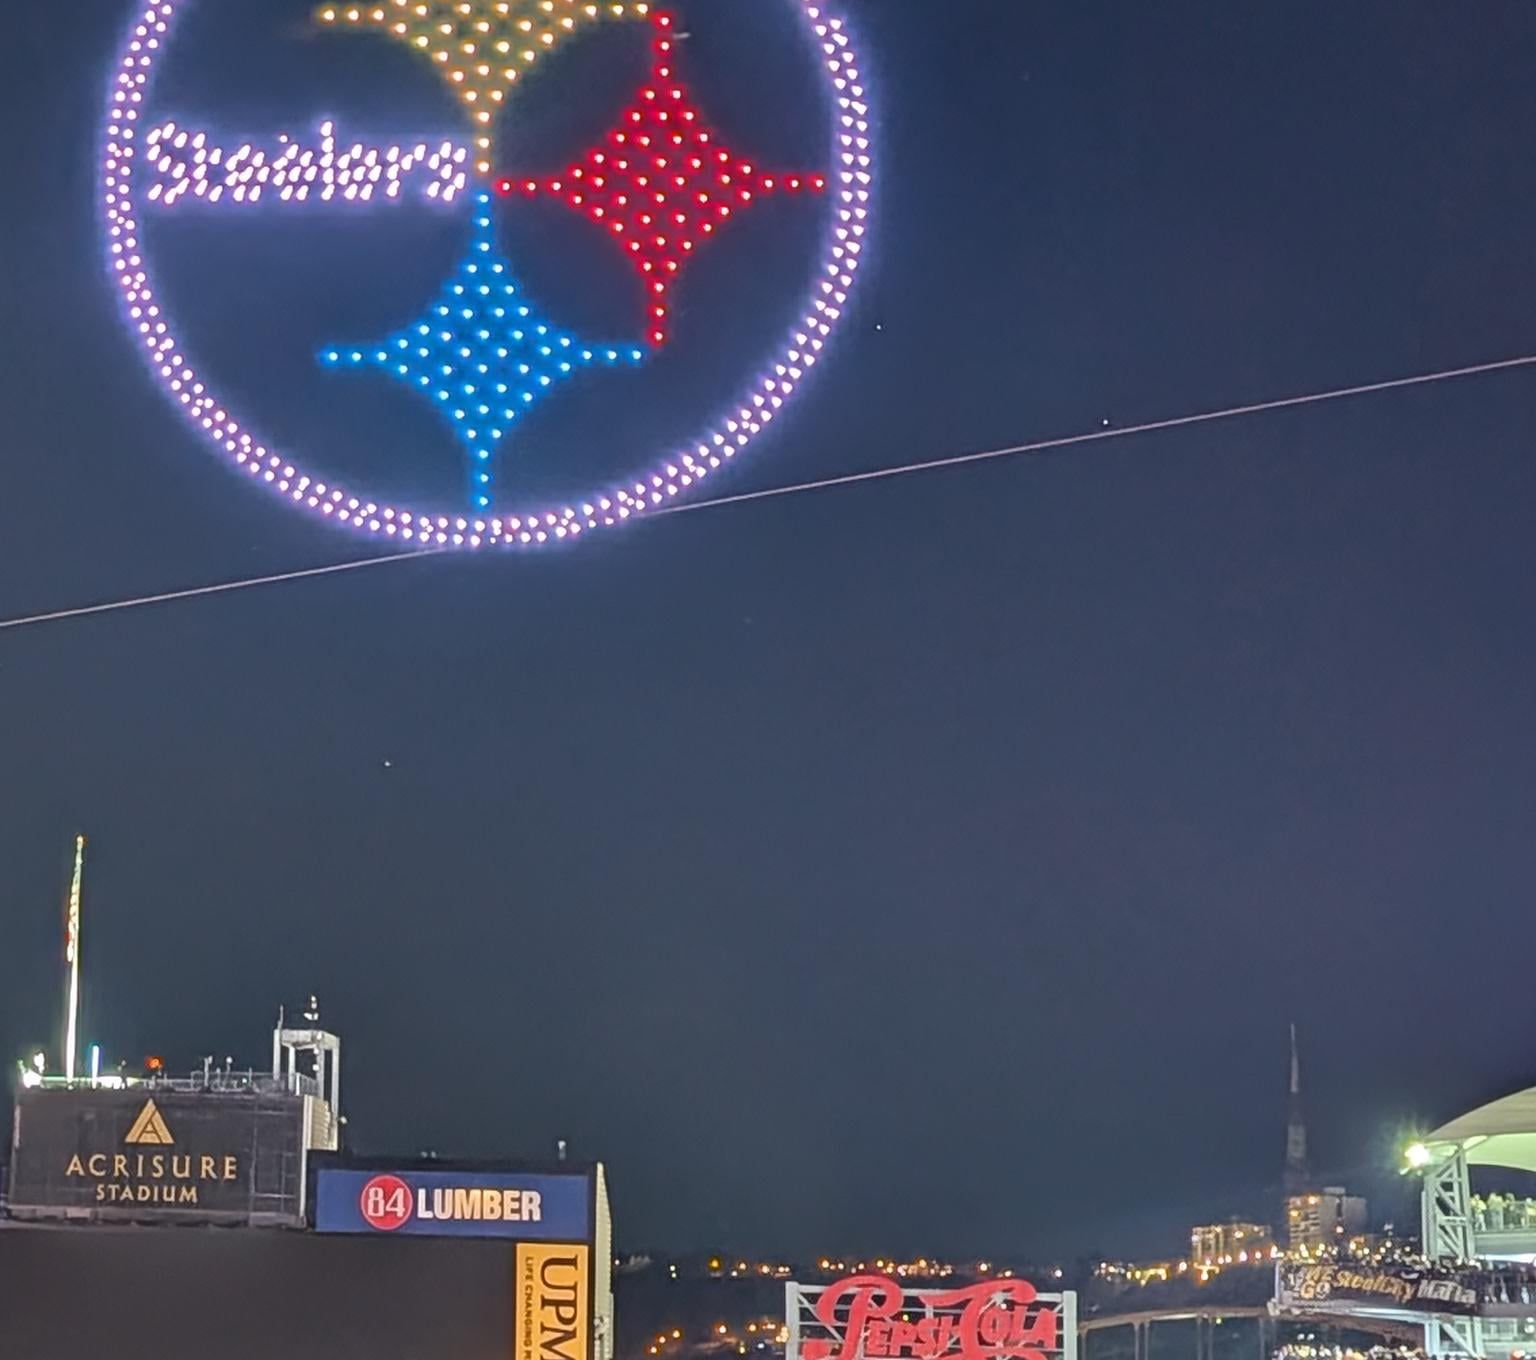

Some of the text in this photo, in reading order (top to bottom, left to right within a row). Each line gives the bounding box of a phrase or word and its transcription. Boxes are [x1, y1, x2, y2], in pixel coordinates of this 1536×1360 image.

[145, 120, 468, 203] Steelers
[66, 1153, 237, 1180] ACRISURE
[96, 1184, 198, 1203] STADIUM
[367, 1187, 541, 1222] 84 LUMBER
[524, 1256, 534, 1280] LIFE
[523, 1284, 533, 1347] CHANGING
